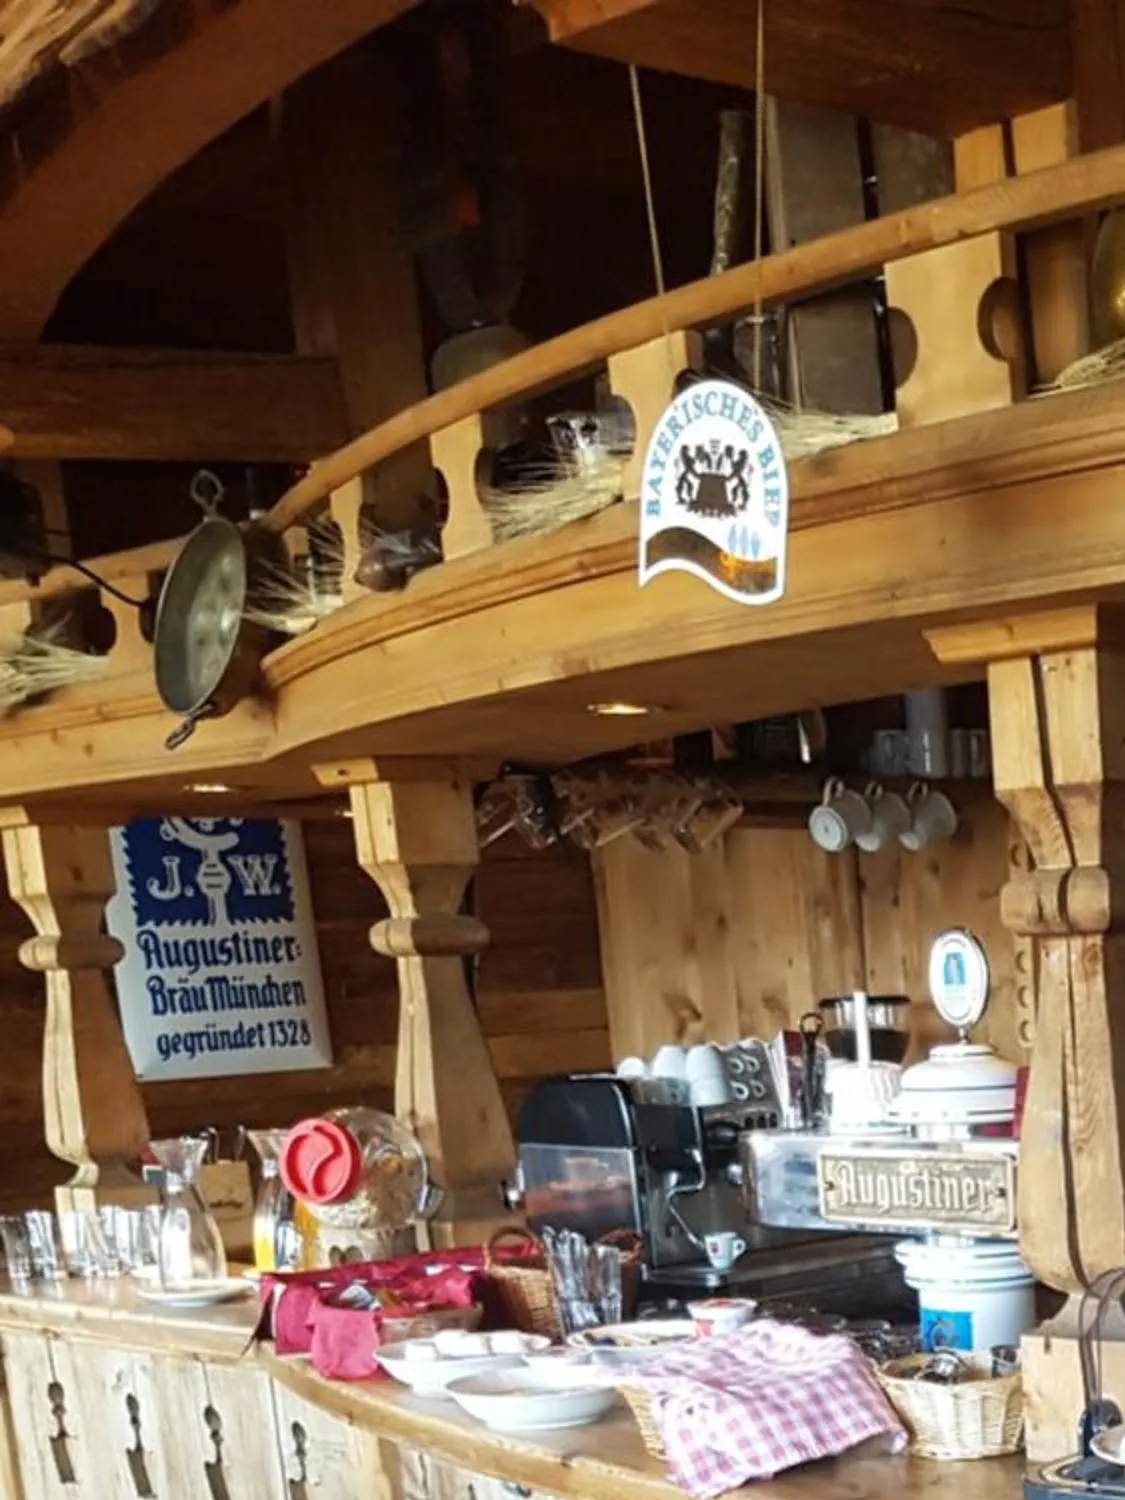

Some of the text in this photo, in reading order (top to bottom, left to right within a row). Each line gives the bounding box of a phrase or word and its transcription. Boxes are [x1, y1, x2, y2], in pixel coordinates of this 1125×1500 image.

[645, 391, 764, 517] BAYERISCHES
[146, 972, 306, 1016] Bräu München
[156, 1018, 311, 1061] gegründet 1328
[840, 1160, 994, 1213] Augustiner
